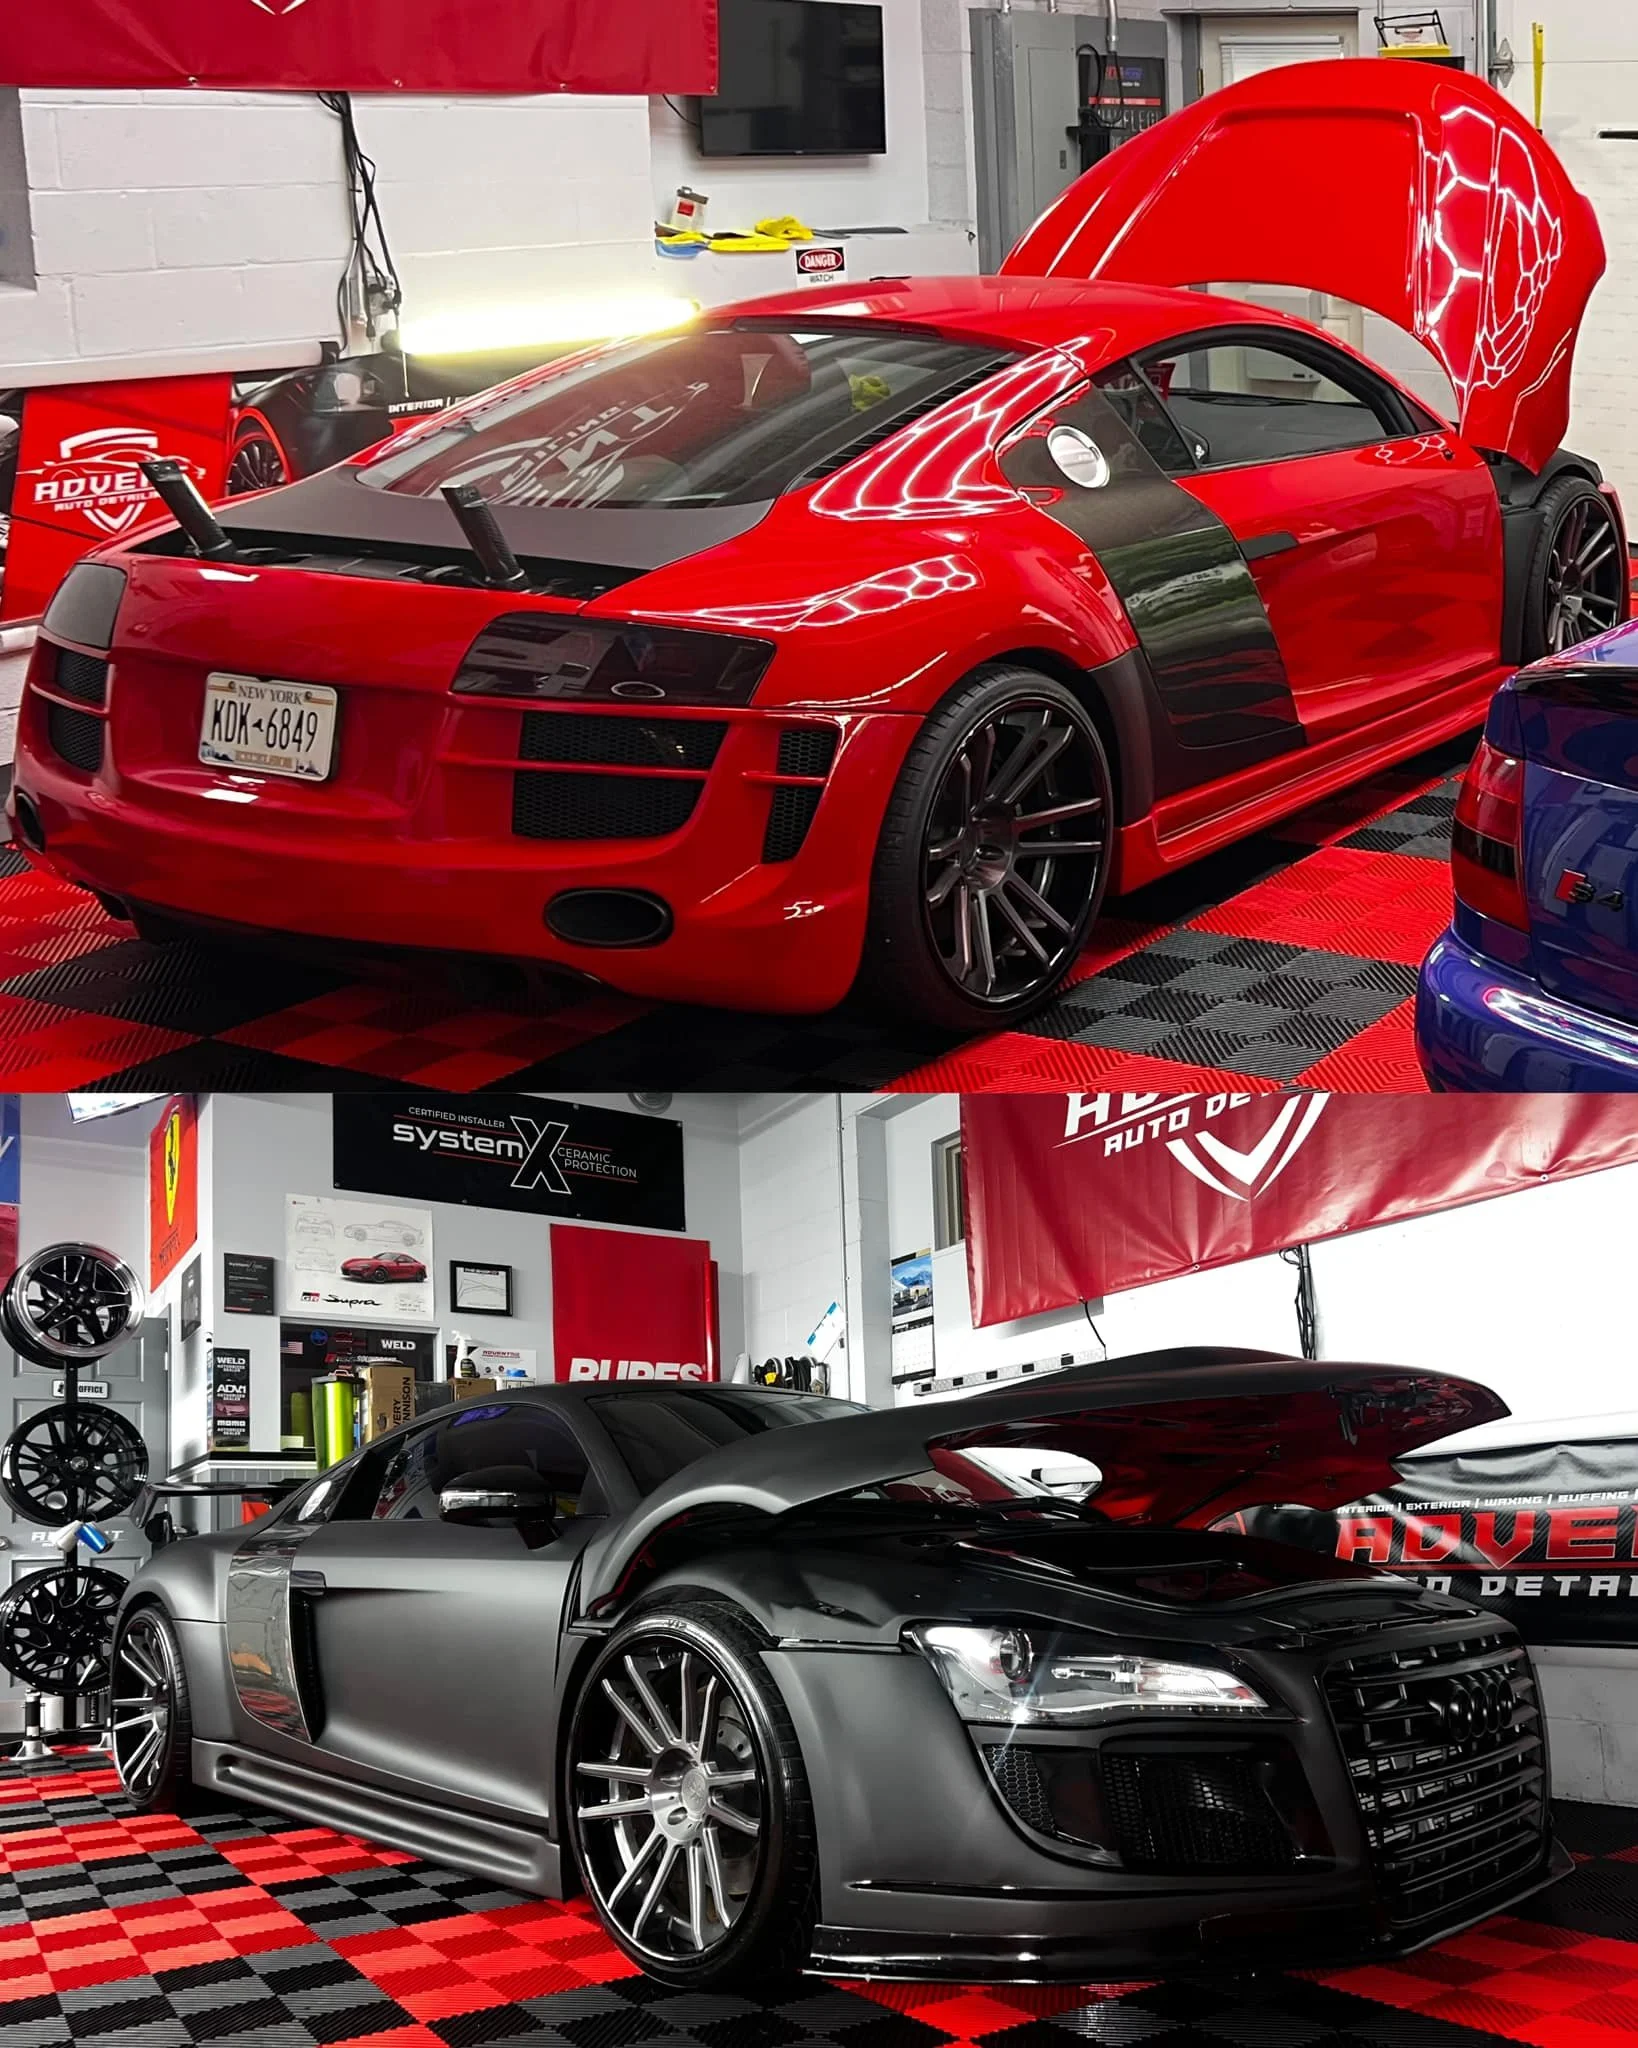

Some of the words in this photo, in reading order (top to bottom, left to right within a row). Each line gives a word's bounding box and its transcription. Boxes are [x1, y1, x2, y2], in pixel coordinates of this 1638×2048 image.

[804, 253, 837, 268] DANGER
[388, 398, 443, 413] INTERIOR
[54, 499, 94, 512] AUTO
[238, 685, 268, 700] NEW
[269, 689, 303, 706] YORK
[266, 707, 318, 753] 6849
[408, 1106, 457, 1121] CERTIFIED
[458, 1114, 506, 1129] INSTALLER
[1103, 1106, 1191, 1157] AUTO
[556, 1147, 612, 1164] CERAMIC
[564, 1158, 638, 1178] PROTECTION
[321, 1294, 383, 1308] Supra
[380, 1338, 417, 1350] WELD
[216, 1356, 246, 1365] WELD
[78, 1385, 104, 1394] OFFICE
[392, 1399, 402, 1428] VERY
[1337, 1503, 1396, 1515] INTERIOR
[1405, 1499, 1471, 1511] EXTERIOR
[1484, 1495, 1543, 1507] WAXING
[1557, 1491, 1629, 1503] BUFFING
[1335, 1504, 1638, 1569] ADVE
